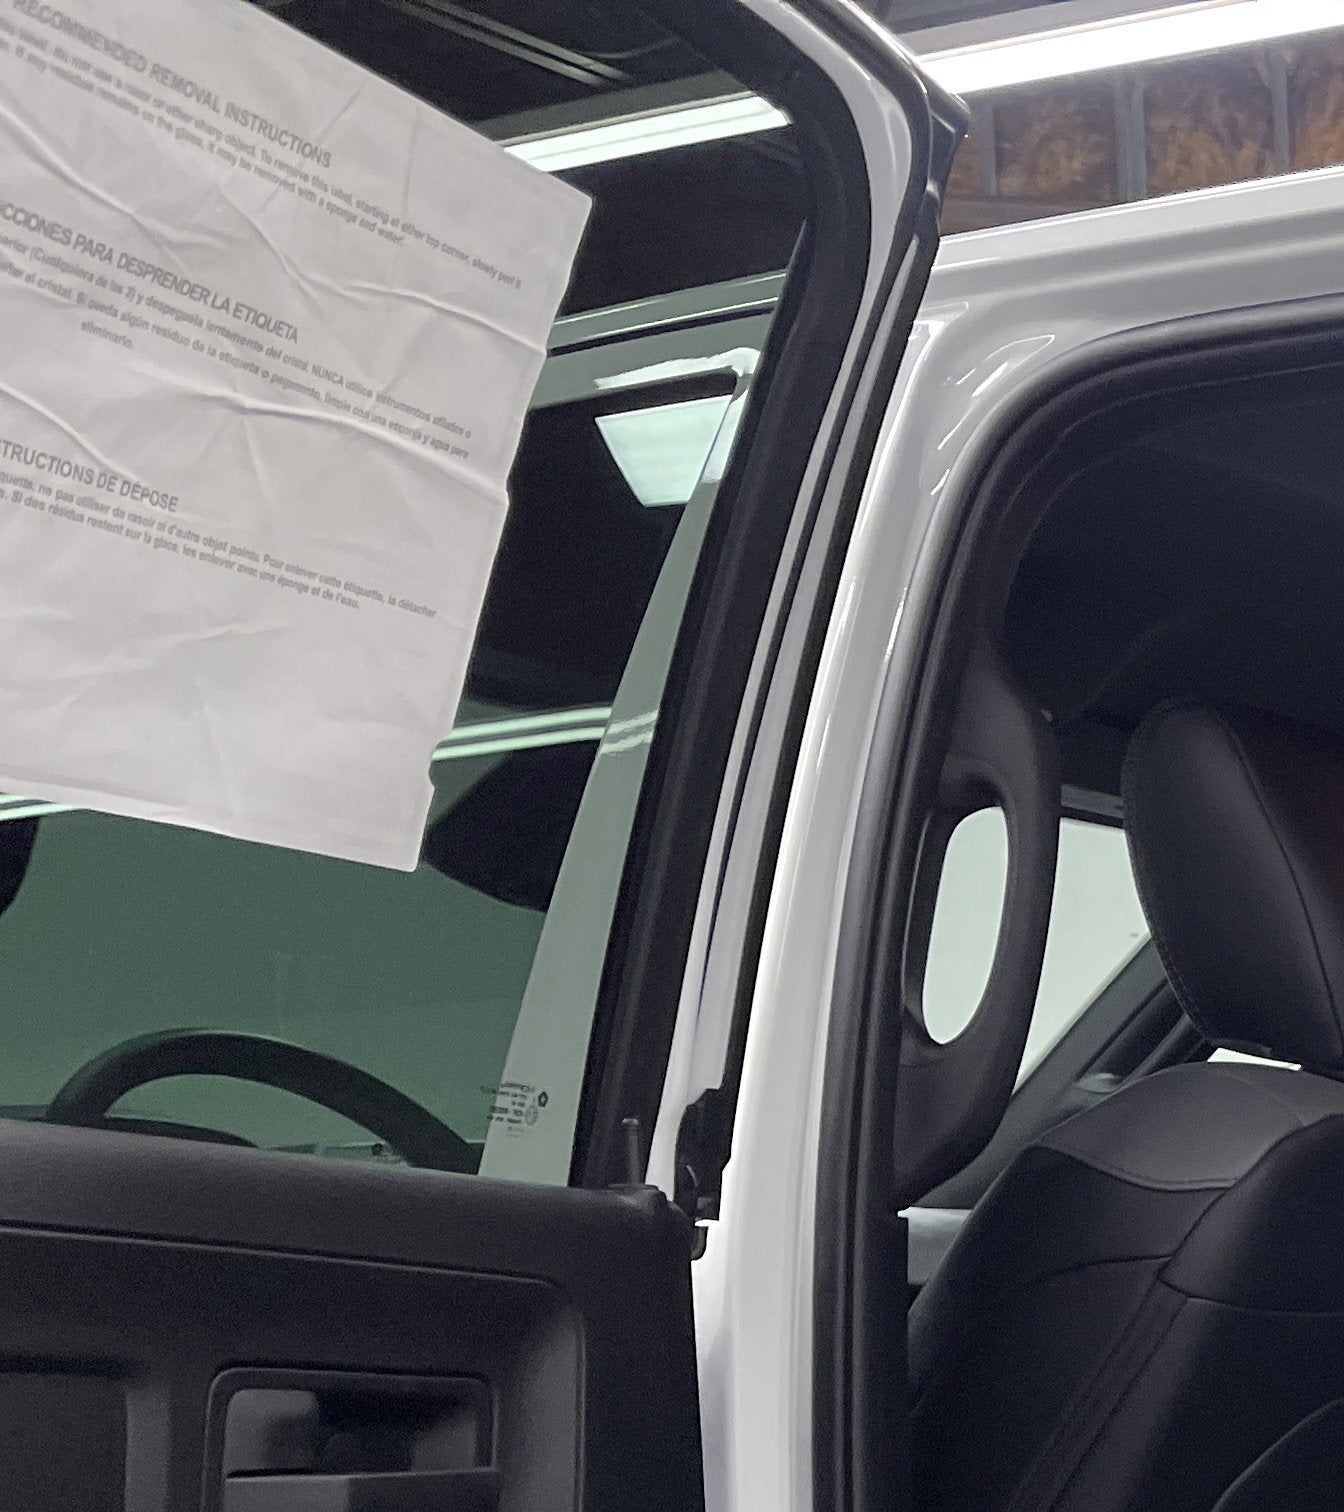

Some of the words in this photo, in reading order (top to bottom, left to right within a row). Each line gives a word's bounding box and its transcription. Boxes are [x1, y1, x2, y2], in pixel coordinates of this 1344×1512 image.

[150, 63, 220, 113] REMOVAL
[224, 102, 331, 168] INSTRUCTIONS
[356, 200, 389, 225] starting
[472, 259, 498, 279] slowly
[359, 218, 377, 232] and
[0, 203, 72, 245] CCIONES
[73, 234, 113, 264] PARA
[117, 253, 210, 305] DESPRENDER
[210, 292, 230, 314] LA
[232, 302, 297, 344] ETIQUETA
[87, 299, 118, 317] queda
[152, 325, 190, 346] residuo
[192, 340, 205, 352] de
[219, 352, 260, 375] etiqueta
[261, 370, 269, 378] o
[206, 320, 263, 352] lentamente
[265, 347, 282, 359] del
[312, 364, 344, 386] NUNCA
[0, 438, 94, 485] TRUCTIONS
[96, 472, 118, 492] DE
[119, 480, 179, 512] DÉPOSE
[24, 497, 45, 511] des
[87, 517, 124, 535] restent
[125, 528, 142, 539] sur
[322, 589, 334, 600] de
[55, 490, 74, 502] pas
[113, 507, 125, 519] de
[264, 554, 284, 568] Pour
